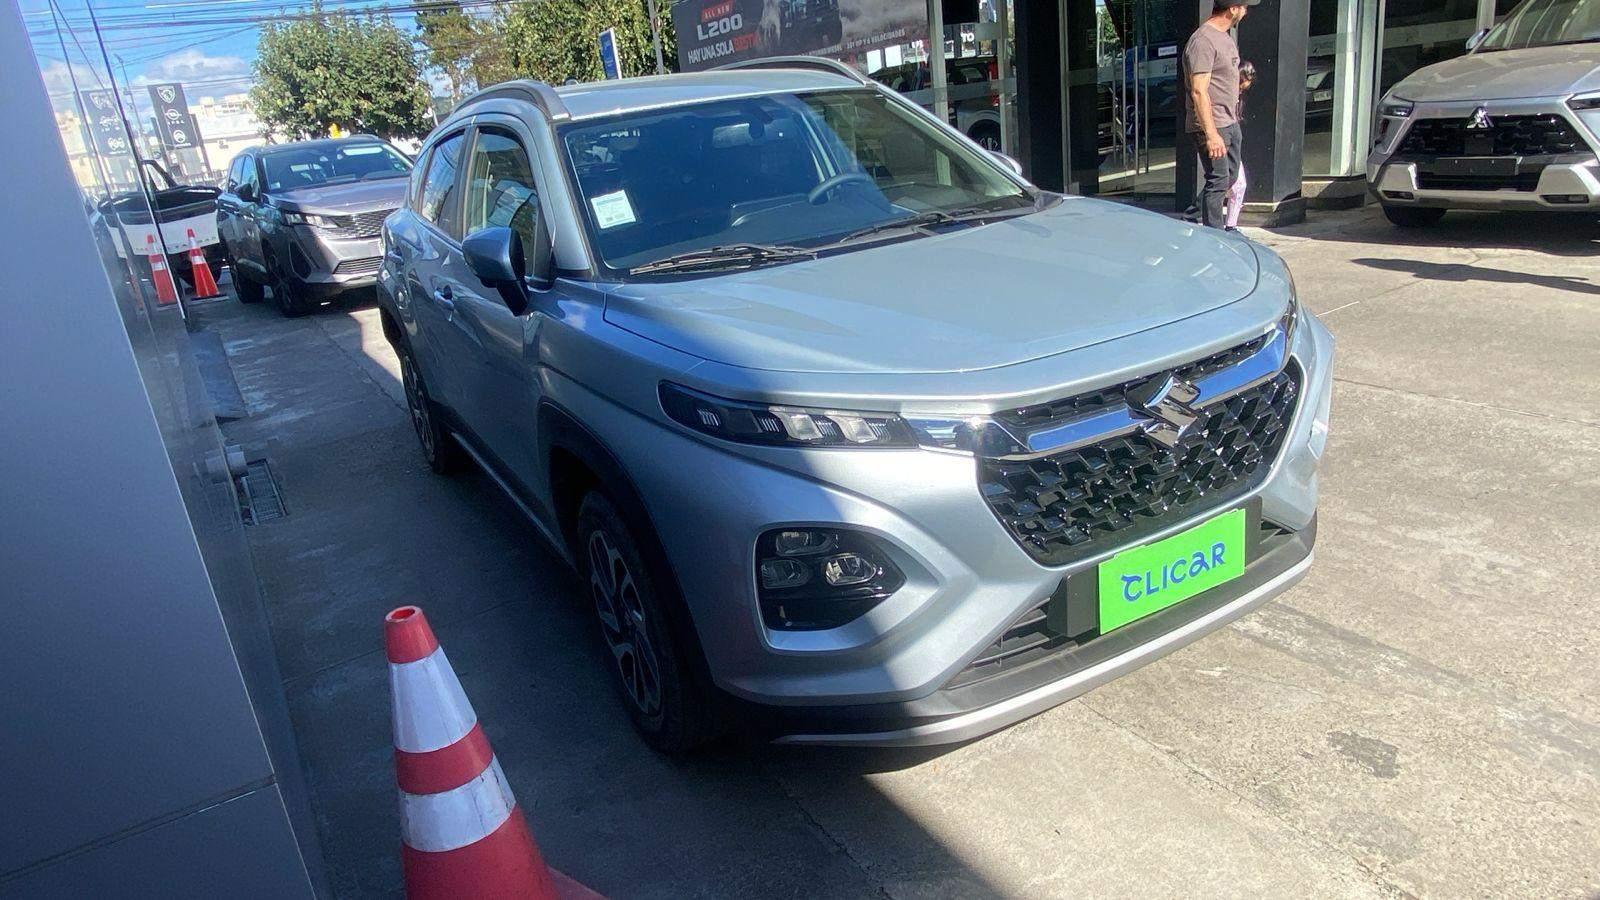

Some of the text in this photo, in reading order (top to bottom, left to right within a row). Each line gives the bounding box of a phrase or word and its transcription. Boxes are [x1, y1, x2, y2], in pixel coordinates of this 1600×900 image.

[696, 13, 743, 41] L200
[687, 47, 701, 64] HAY
[700, 44, 716, 61] UNA
[716, 39, 735, 57] SOLA
[1120, 541, 1226, 602] CLICAR
